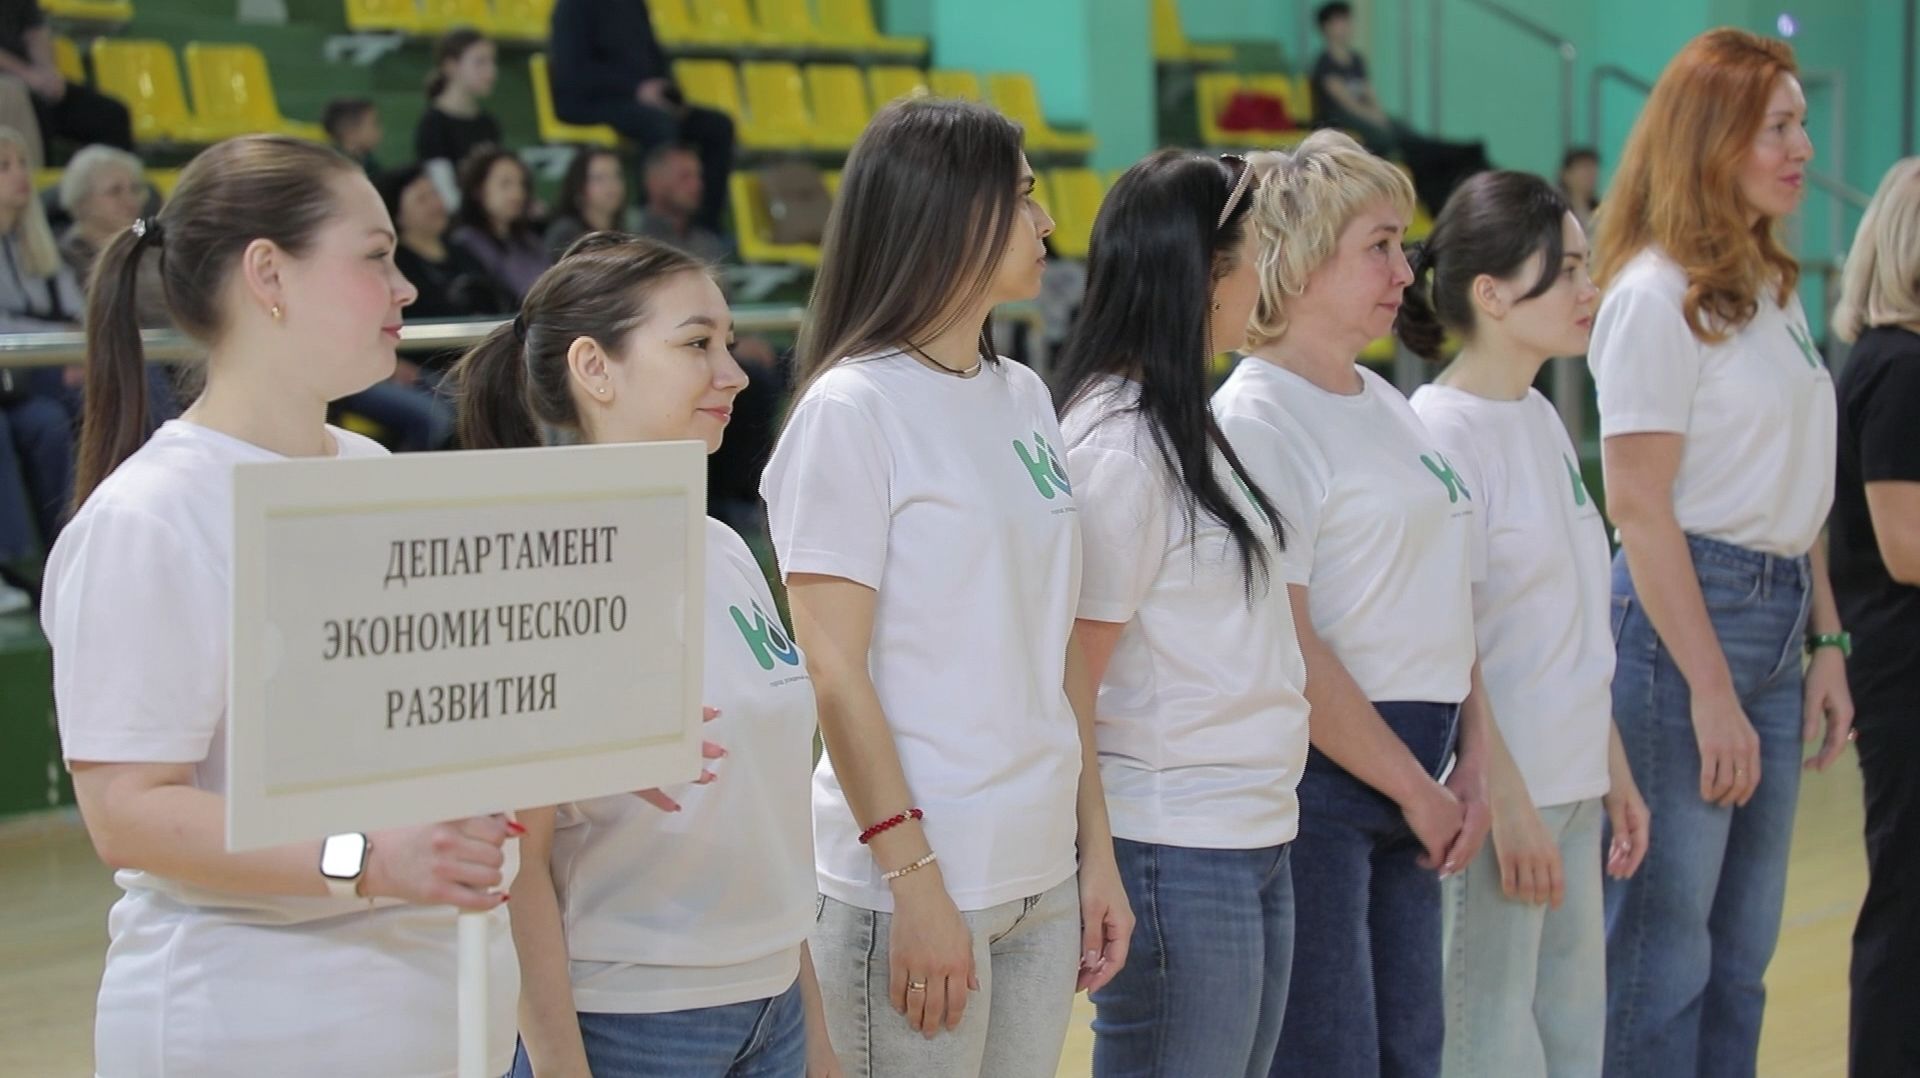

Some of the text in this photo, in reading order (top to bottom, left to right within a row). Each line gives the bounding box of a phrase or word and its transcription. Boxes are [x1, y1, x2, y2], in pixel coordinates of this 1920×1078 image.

[384, 526, 618, 589] ДЕПАРТАМЕНТ
[322, 595, 627, 661] ЭКОНОМИЧЕСКОГО
[385, 672, 558, 729] РАЗВИТИЯ
